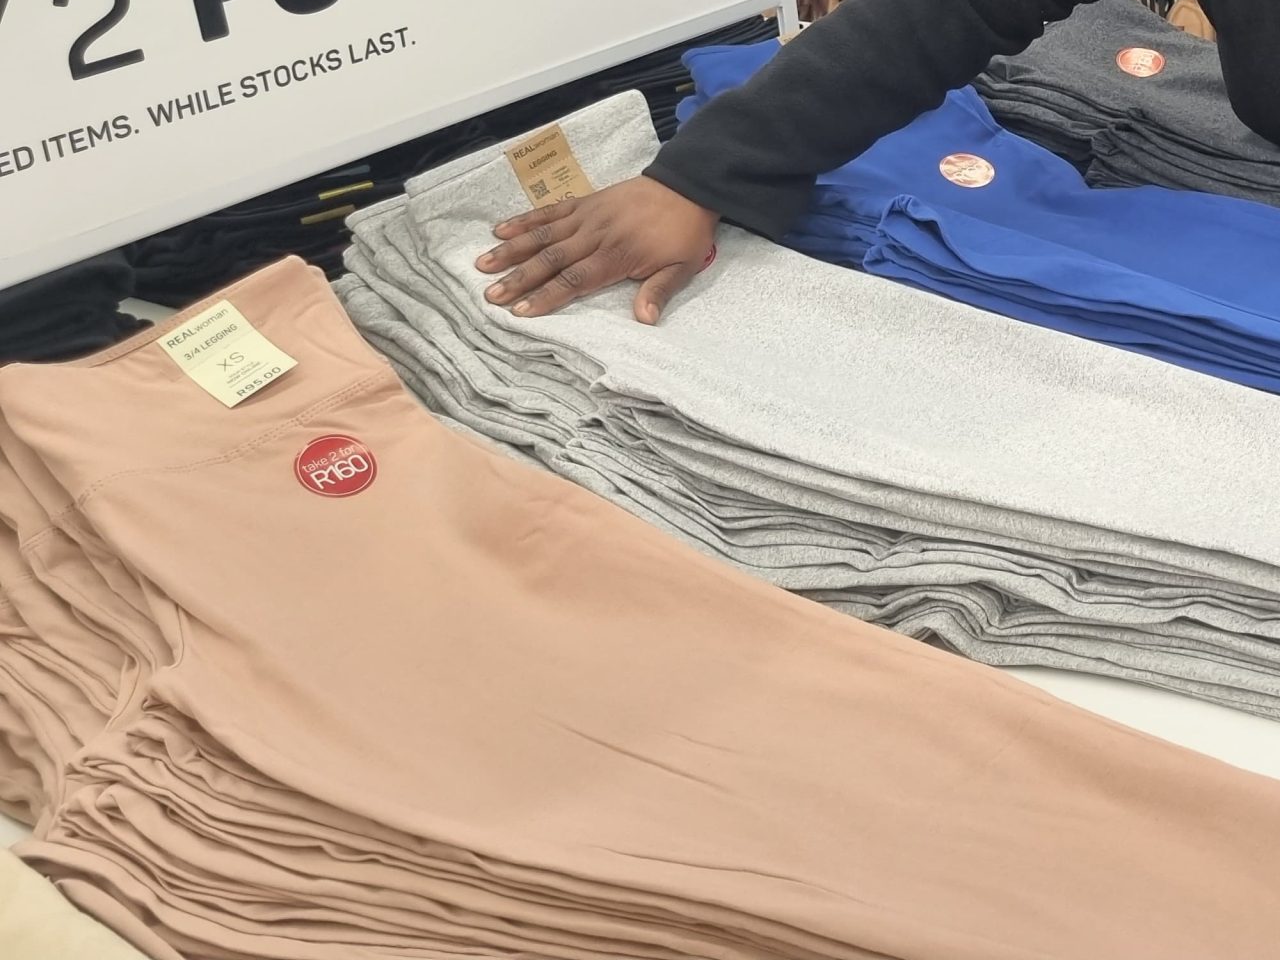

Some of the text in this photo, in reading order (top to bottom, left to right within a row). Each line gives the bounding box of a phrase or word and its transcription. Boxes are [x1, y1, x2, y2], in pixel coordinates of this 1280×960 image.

[41, 115, 140, 162] ITEMS.
[146, 82, 236, 127] WHILE
[239, 49, 343, 98] STOCKS
[348, 26, 416, 64] LAST.
[528, 149, 558, 170] LEGGING
[183, 323, 238, 361] 3/4 LEGGING
[216, 351, 245, 372] XS
[236, 366, 282, 397] R95.00
[302, 445, 355, 473] take 2 for
[310, 454, 369, 489] R160
